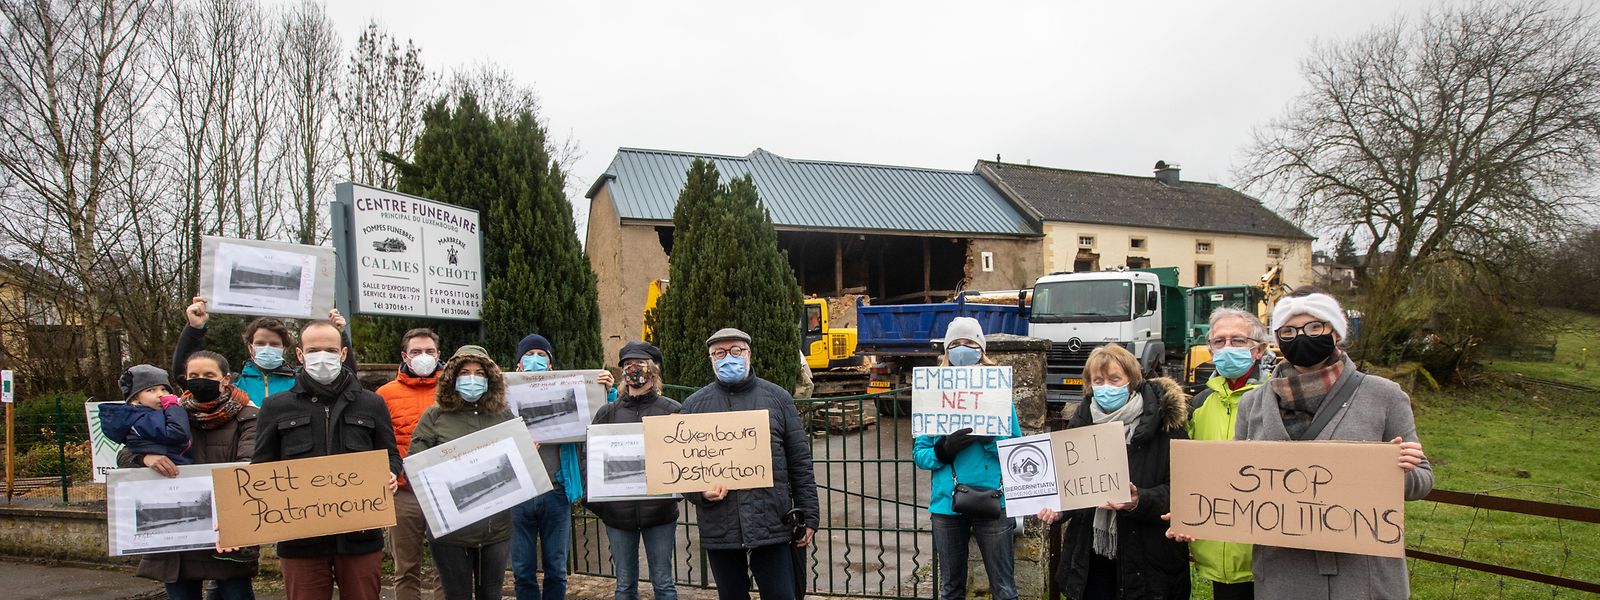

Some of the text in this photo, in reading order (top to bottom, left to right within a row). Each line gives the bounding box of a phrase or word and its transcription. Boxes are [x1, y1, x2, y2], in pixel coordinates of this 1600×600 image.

[357, 198, 476, 234] CENTRE FUNERAIRE
[381, 212, 411, 221] PRINCIPAL
[422, 217, 459, 233] LUXEMBOURG
[362, 224, 415, 242] POMPES FUNEBRES
[437, 236, 466, 249] MARBRERIE
[361, 255, 419, 274] CALMES
[429, 265, 478, 280] SCHOTT
[362, 282, 420, 293] SALLE D'EXPOSITION
[363, 290, 386, 298] SERVICE
[389, 292, 406, 300] 24/24
[430, 288, 479, 299] EXPOSITIONS
[385, 303, 413, 311] 370161-1
[430, 297, 480, 308] FUNERAIRES
[450, 308, 470, 316] 310066
[914, 368, 1012, 390] EMBAUEN
[941, 391, 983, 410] NET
[663, 421, 757, 450] Luxembourg
[682, 445, 733, 459] under
[662, 460, 765, 485] Destruction
[1230, 464, 1333, 500] STOP
[233, 466, 364, 501] Rett eise
[1005, 481, 1055, 492] BIERGERINITIATIV
[1063, 472, 1120, 497] KIELEN
[243, 486, 388, 532] Patrimoine!
[1181, 493, 1403, 545] DEMOLITIONS
